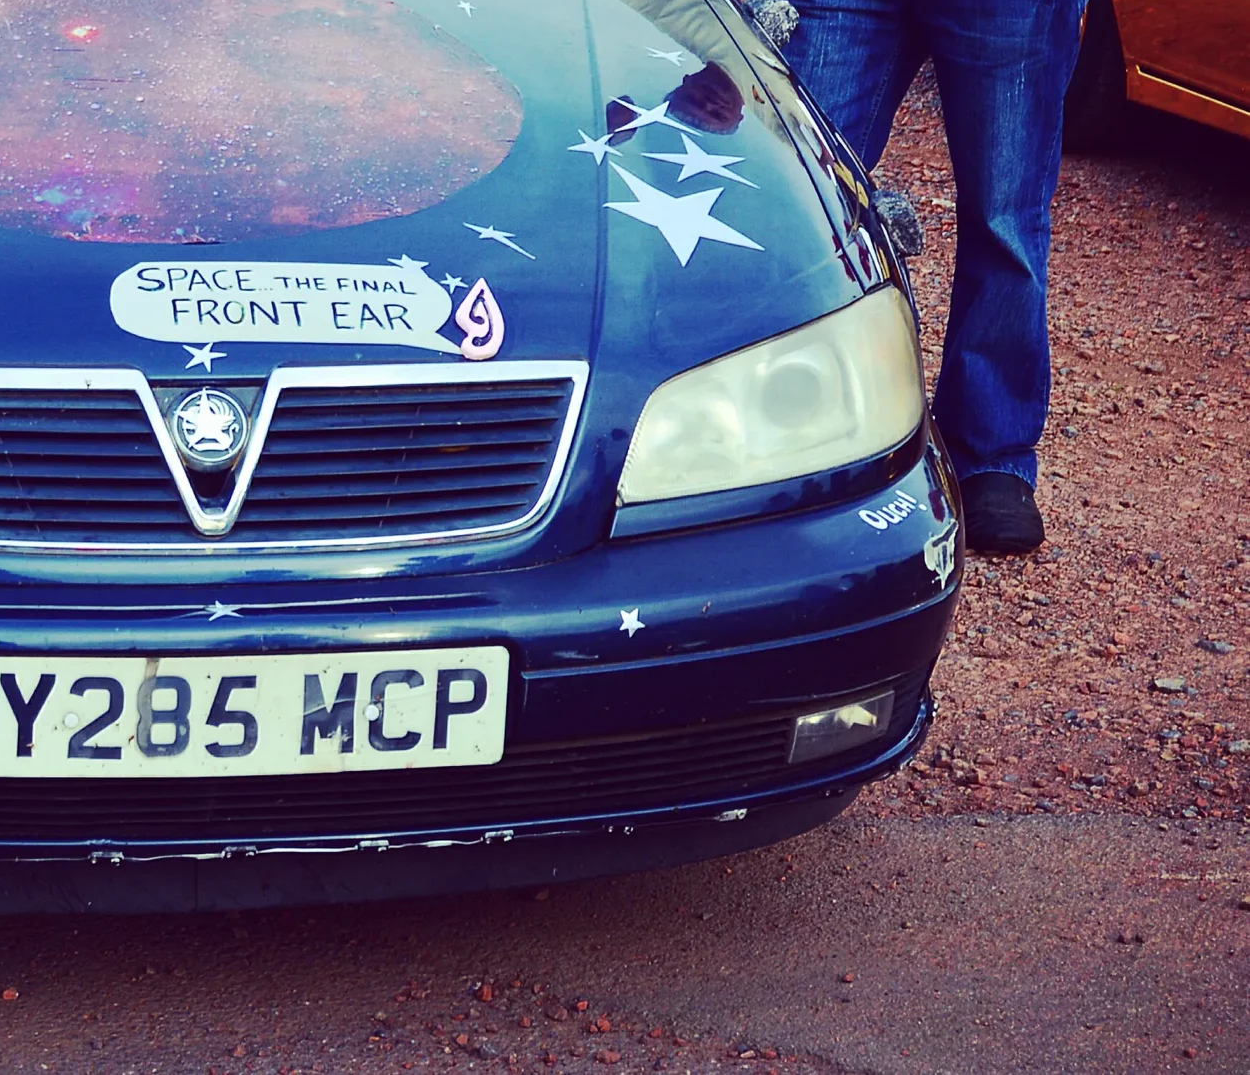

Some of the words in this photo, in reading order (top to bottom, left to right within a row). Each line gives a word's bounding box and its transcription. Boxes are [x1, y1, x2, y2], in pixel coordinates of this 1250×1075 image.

[274, 276, 327, 290] THE
[338, 277, 417, 294] FINAL
[172, 299, 307, 326] FRONT
[332, 302, 412, 329] EAR
[0, 673, 259, 759] Y285
[300, 669, 488, 755] MCP
